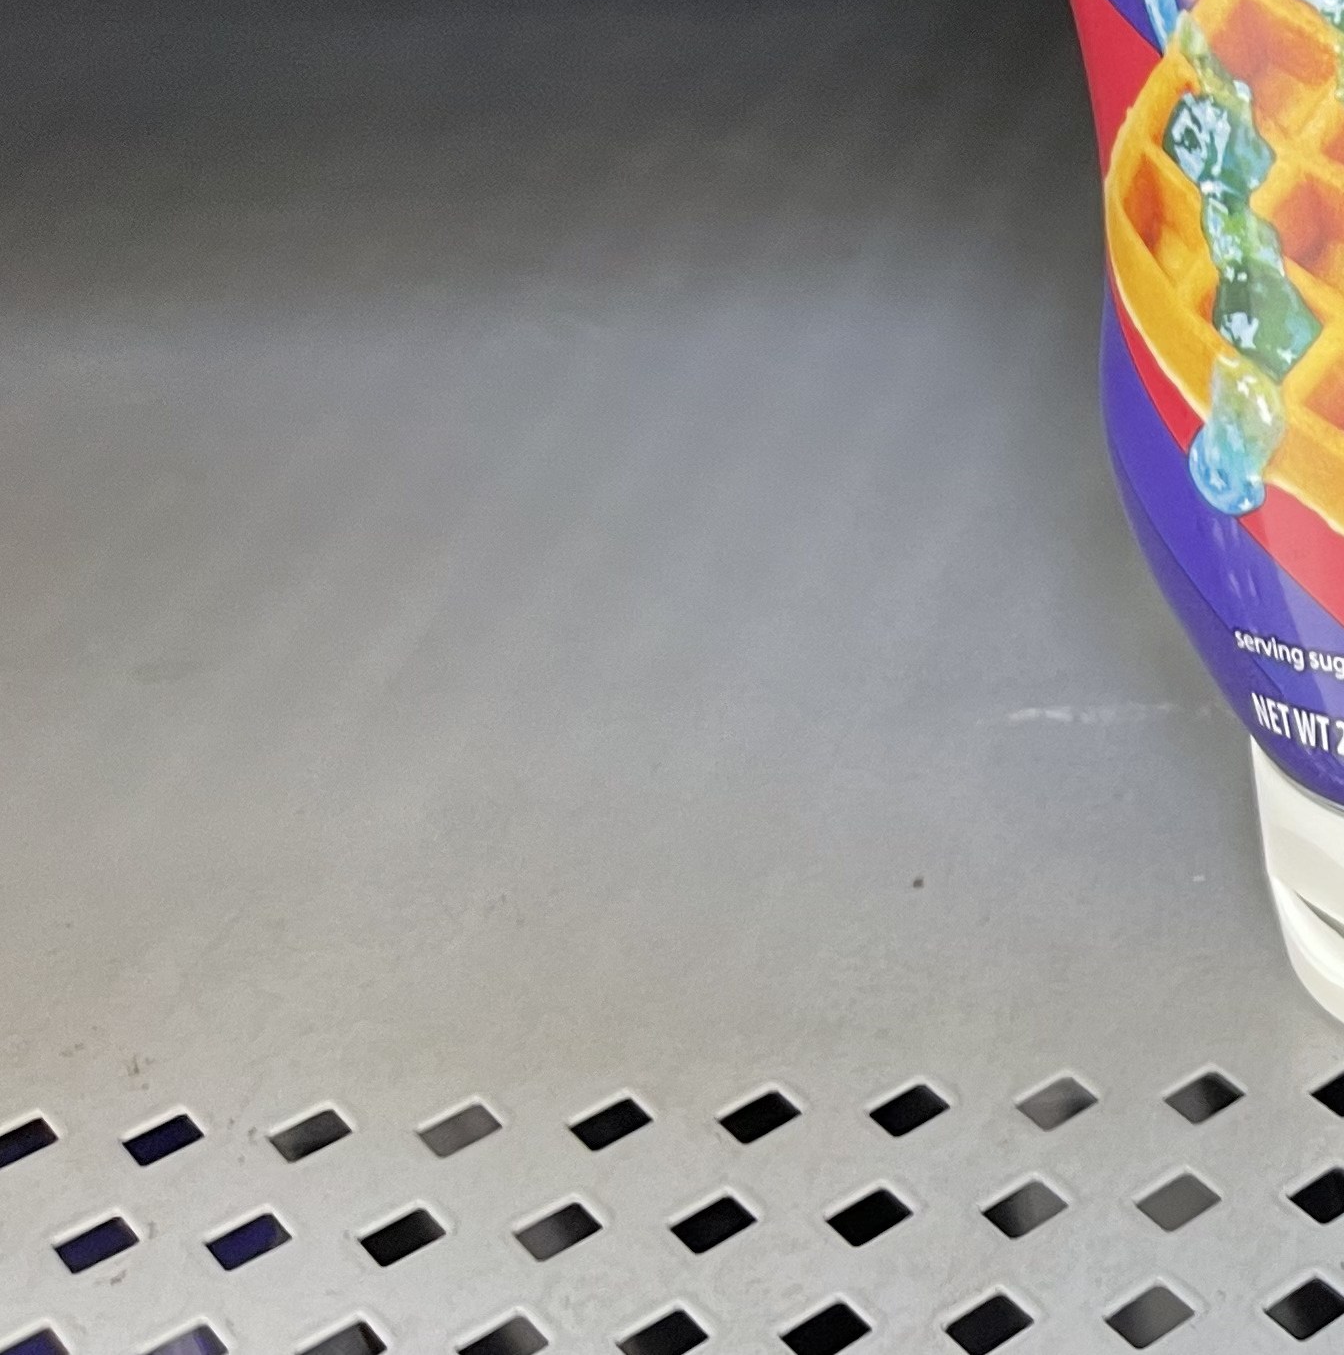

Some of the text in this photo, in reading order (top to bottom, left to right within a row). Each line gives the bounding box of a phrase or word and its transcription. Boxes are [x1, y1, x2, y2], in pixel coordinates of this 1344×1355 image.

[1234, 629, 1304, 671] serving
[1251, 692, 1291, 738] NET
[1294, 711, 1331, 751] WT
